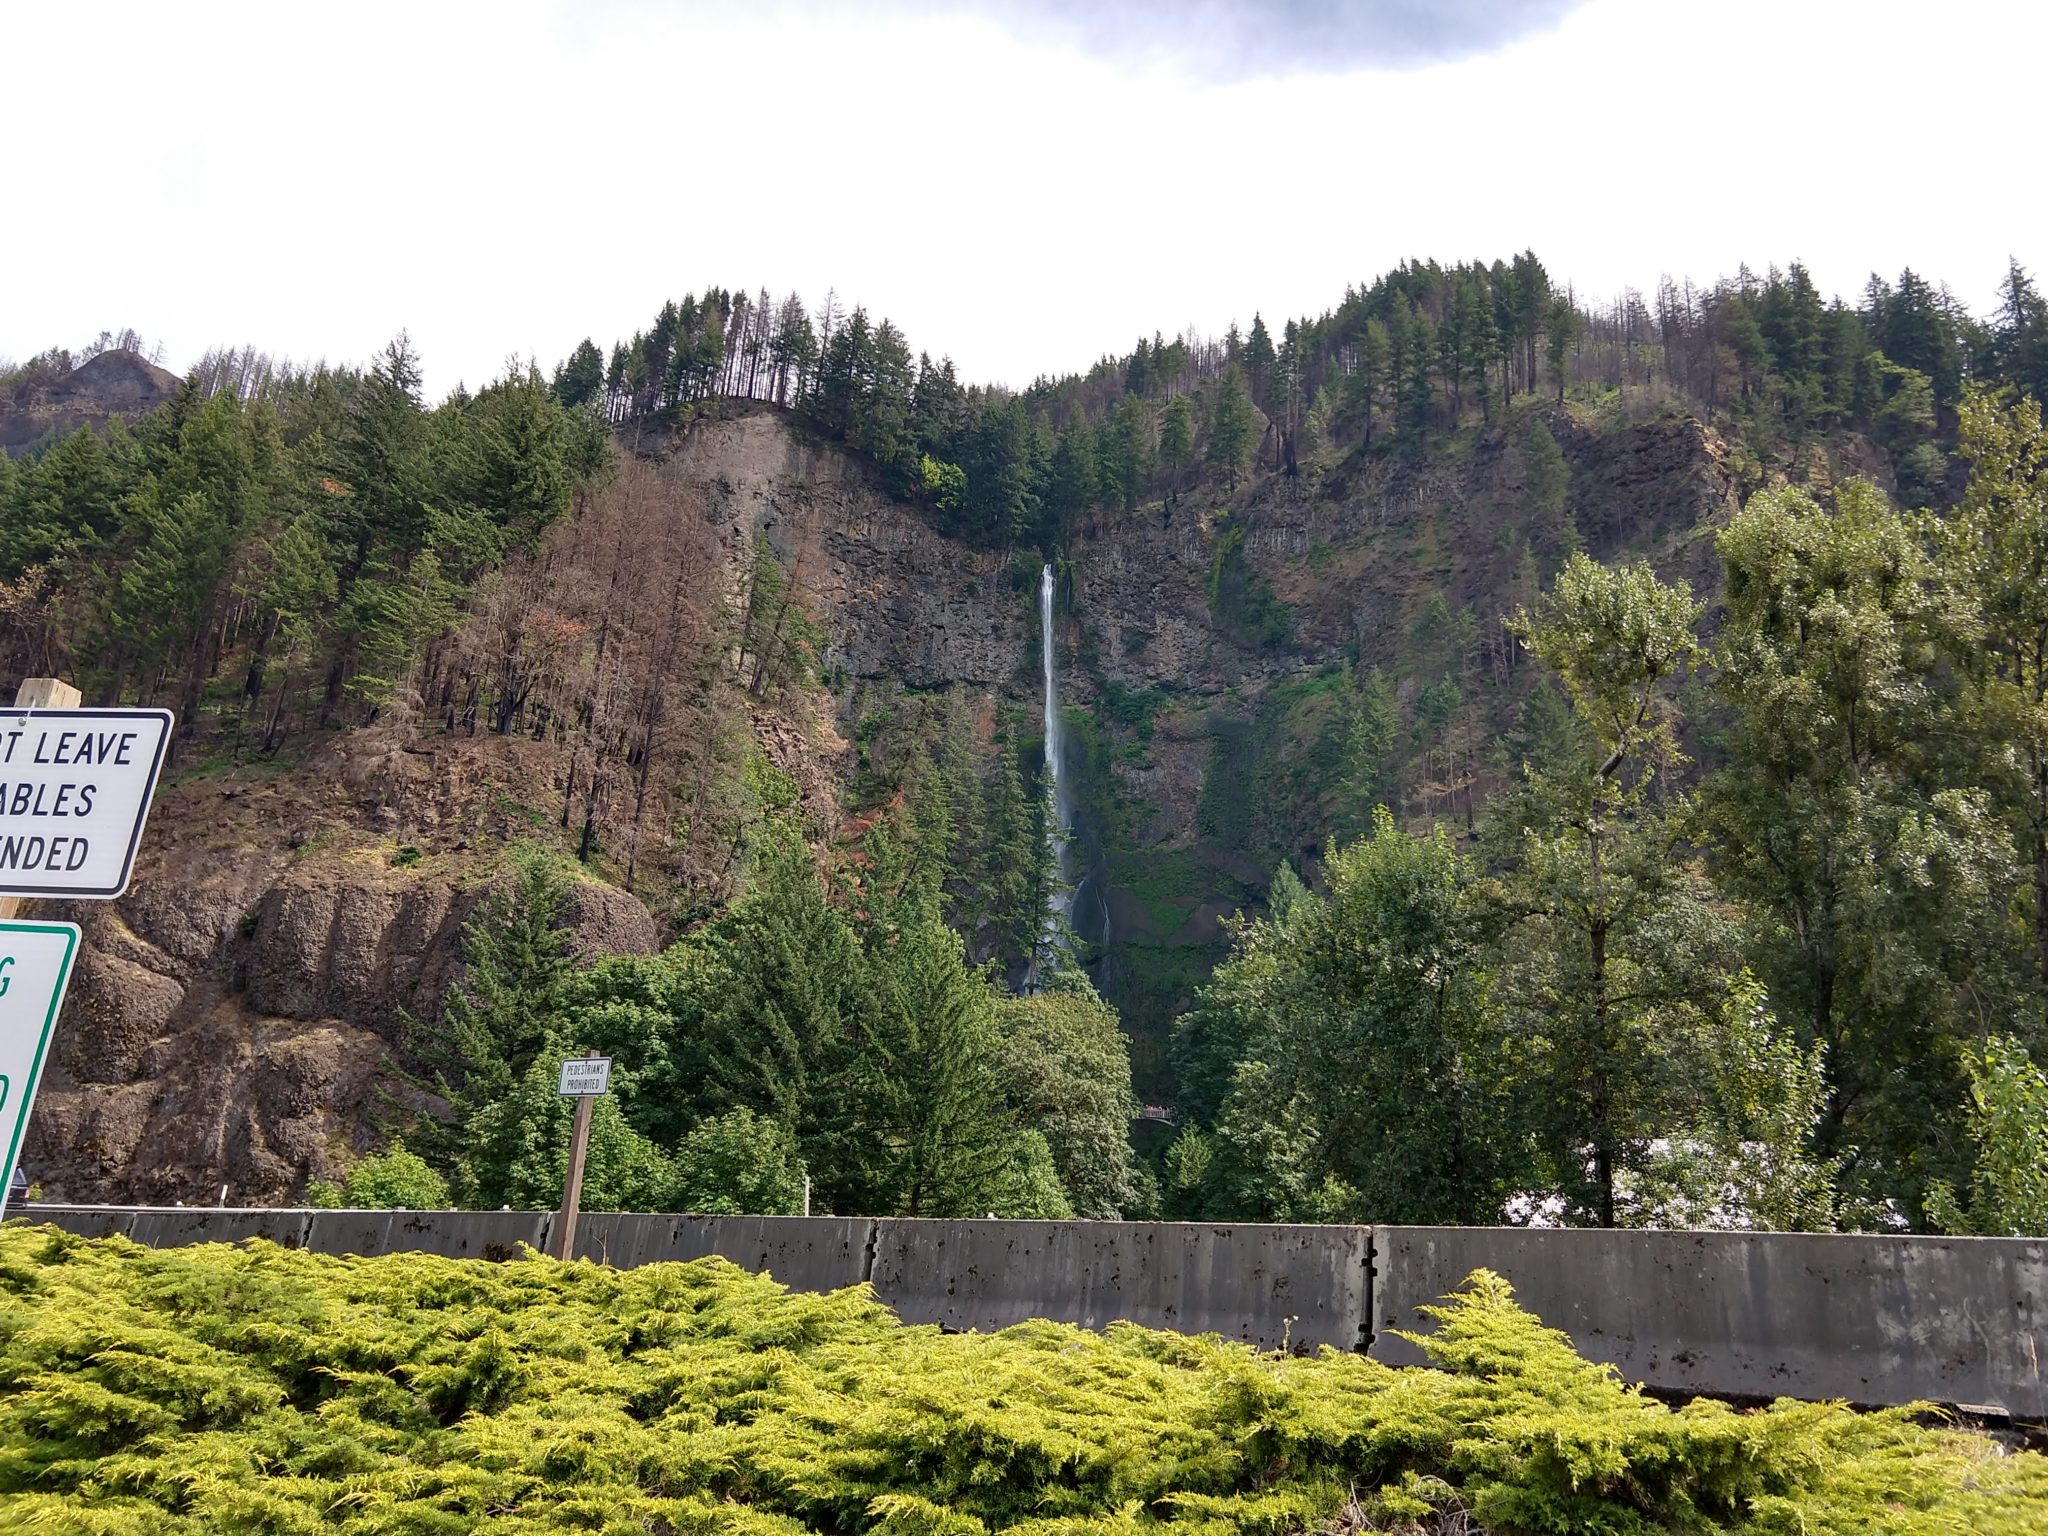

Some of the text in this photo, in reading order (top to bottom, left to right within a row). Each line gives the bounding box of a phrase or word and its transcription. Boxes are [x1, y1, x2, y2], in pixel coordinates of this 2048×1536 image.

[0, 731, 138, 765] T LEAVE
[0, 835, 89, 871] NDED
[567, 1063, 604, 1076] PEDESTRIANS
[567, 1079, 600, 1090] PROHIBITED
